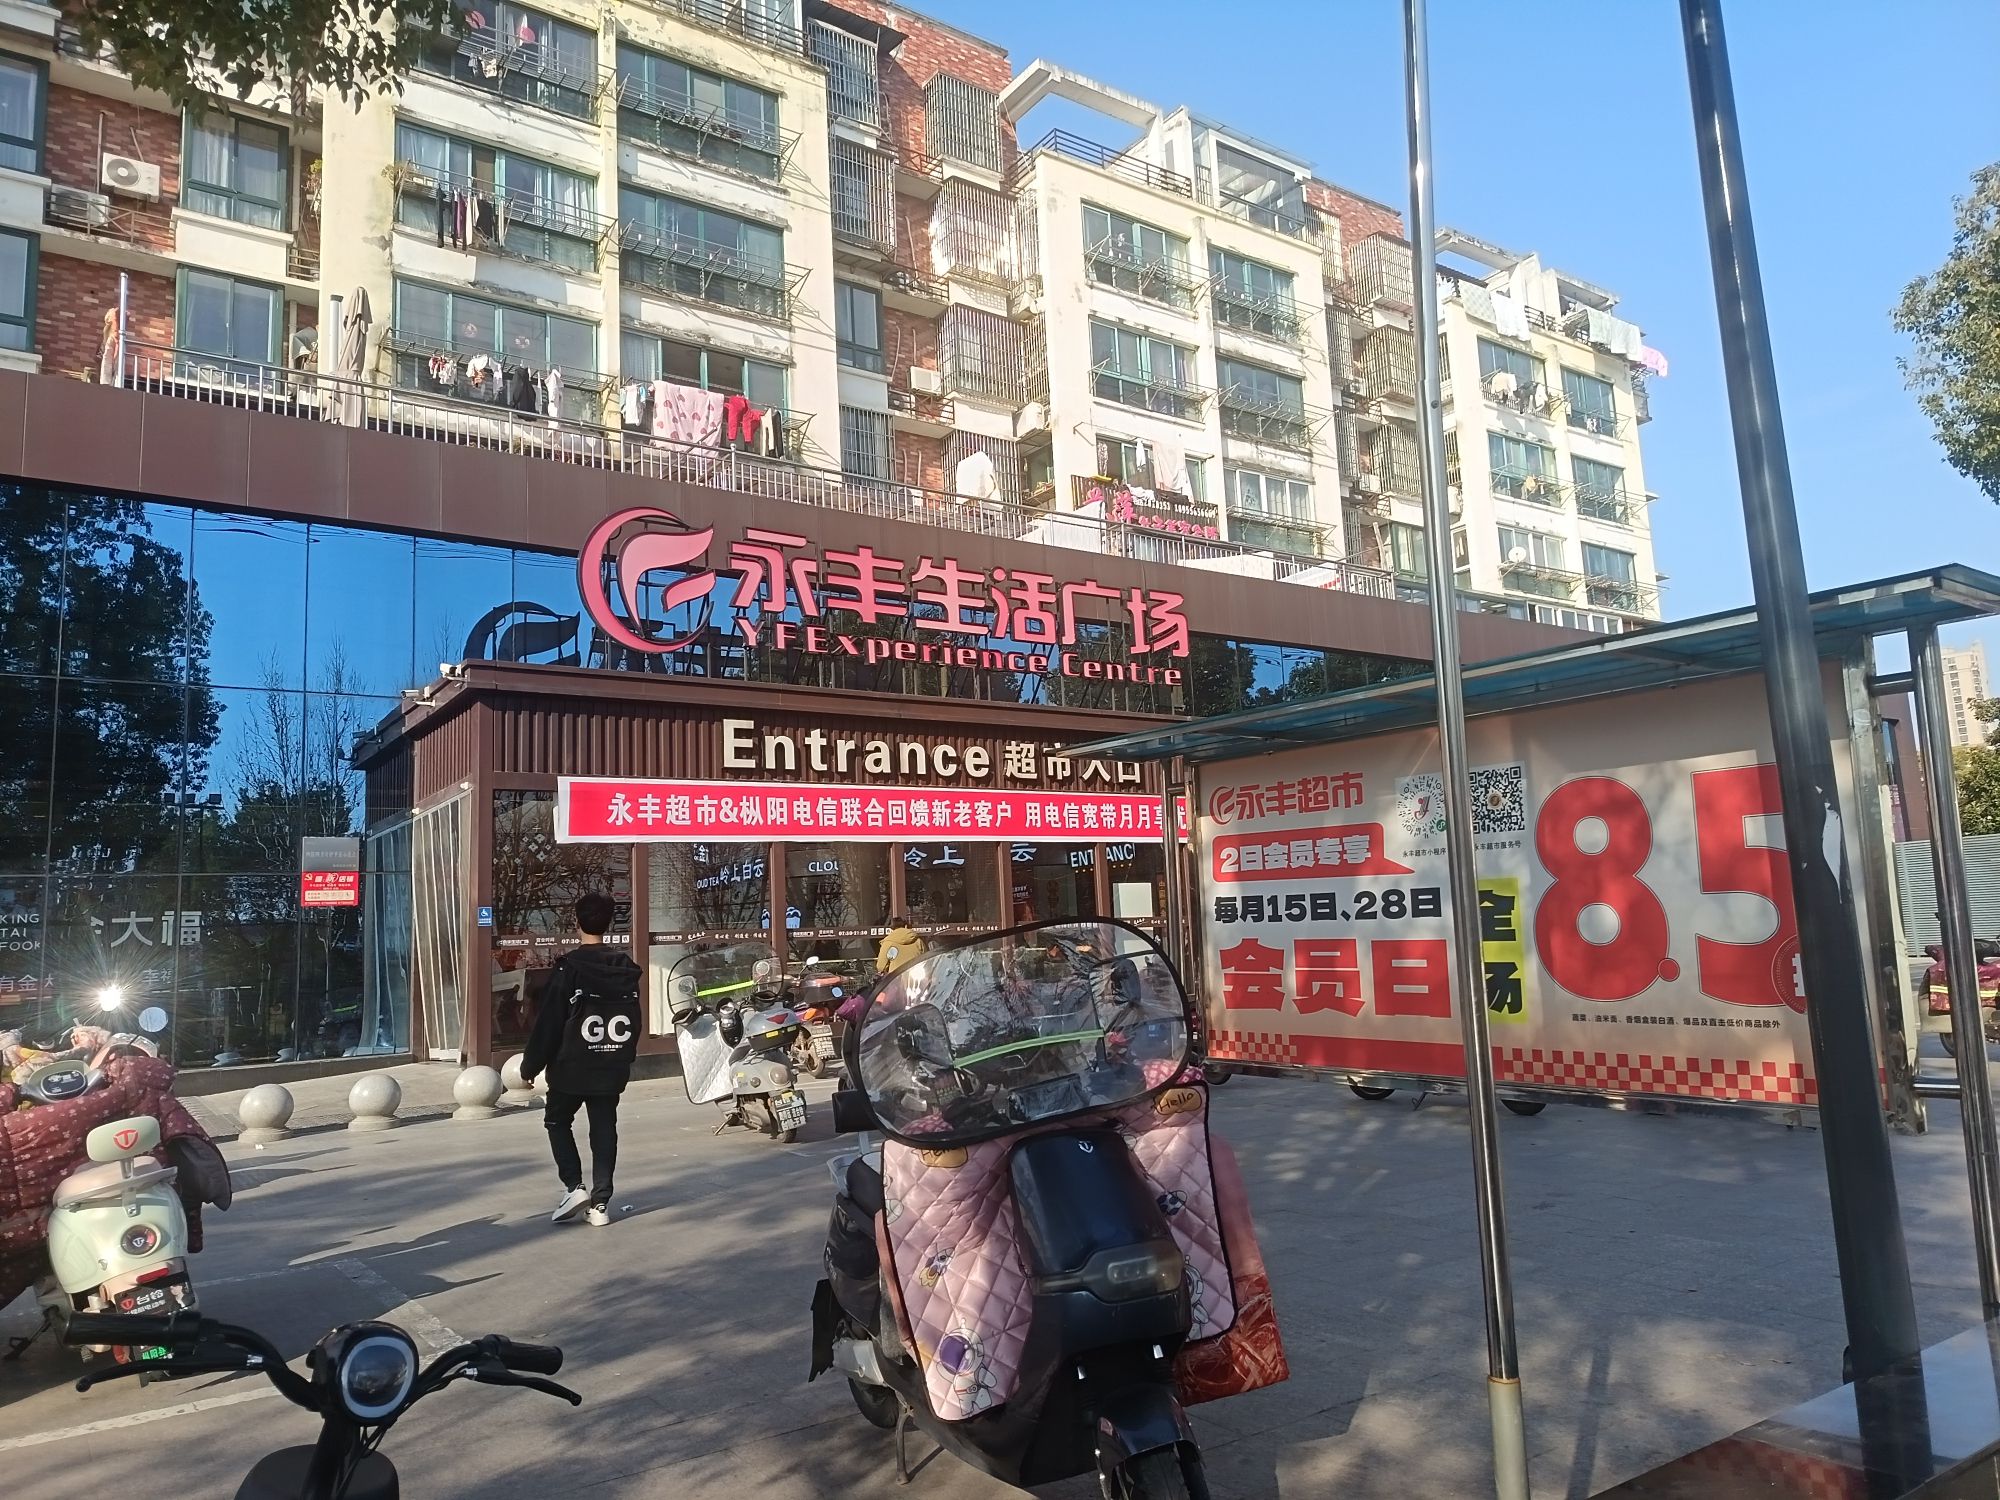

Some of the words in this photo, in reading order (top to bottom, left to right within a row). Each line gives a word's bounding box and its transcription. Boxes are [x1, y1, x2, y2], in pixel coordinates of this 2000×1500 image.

[729, 527, 1189, 657] 永丰生活广场
[1062, 652, 1182, 685] Centre
[722, 719, 990, 776] Entrance
[607, 793, 1012, 829] 永丰超市&枞阳电信联合回馈新老客户
[1236, 772, 1363, 820] 永丰超市
[719, 858, 764, 885] 岭上白云
[1220, 835, 1371, 873] 2日会员专享
[1534, 763, 1799, 1007] 8.5
[0, 913, 40, 925] KING
[1214, 887, 1442, 923] 每月15日、28日
[0, 927, 27, 938] TAI
[1219, 938, 1451, 1018] 会员日
[581, 1015, 631, 1042] GC
[1160, 1091, 1194, 1112] Hello
